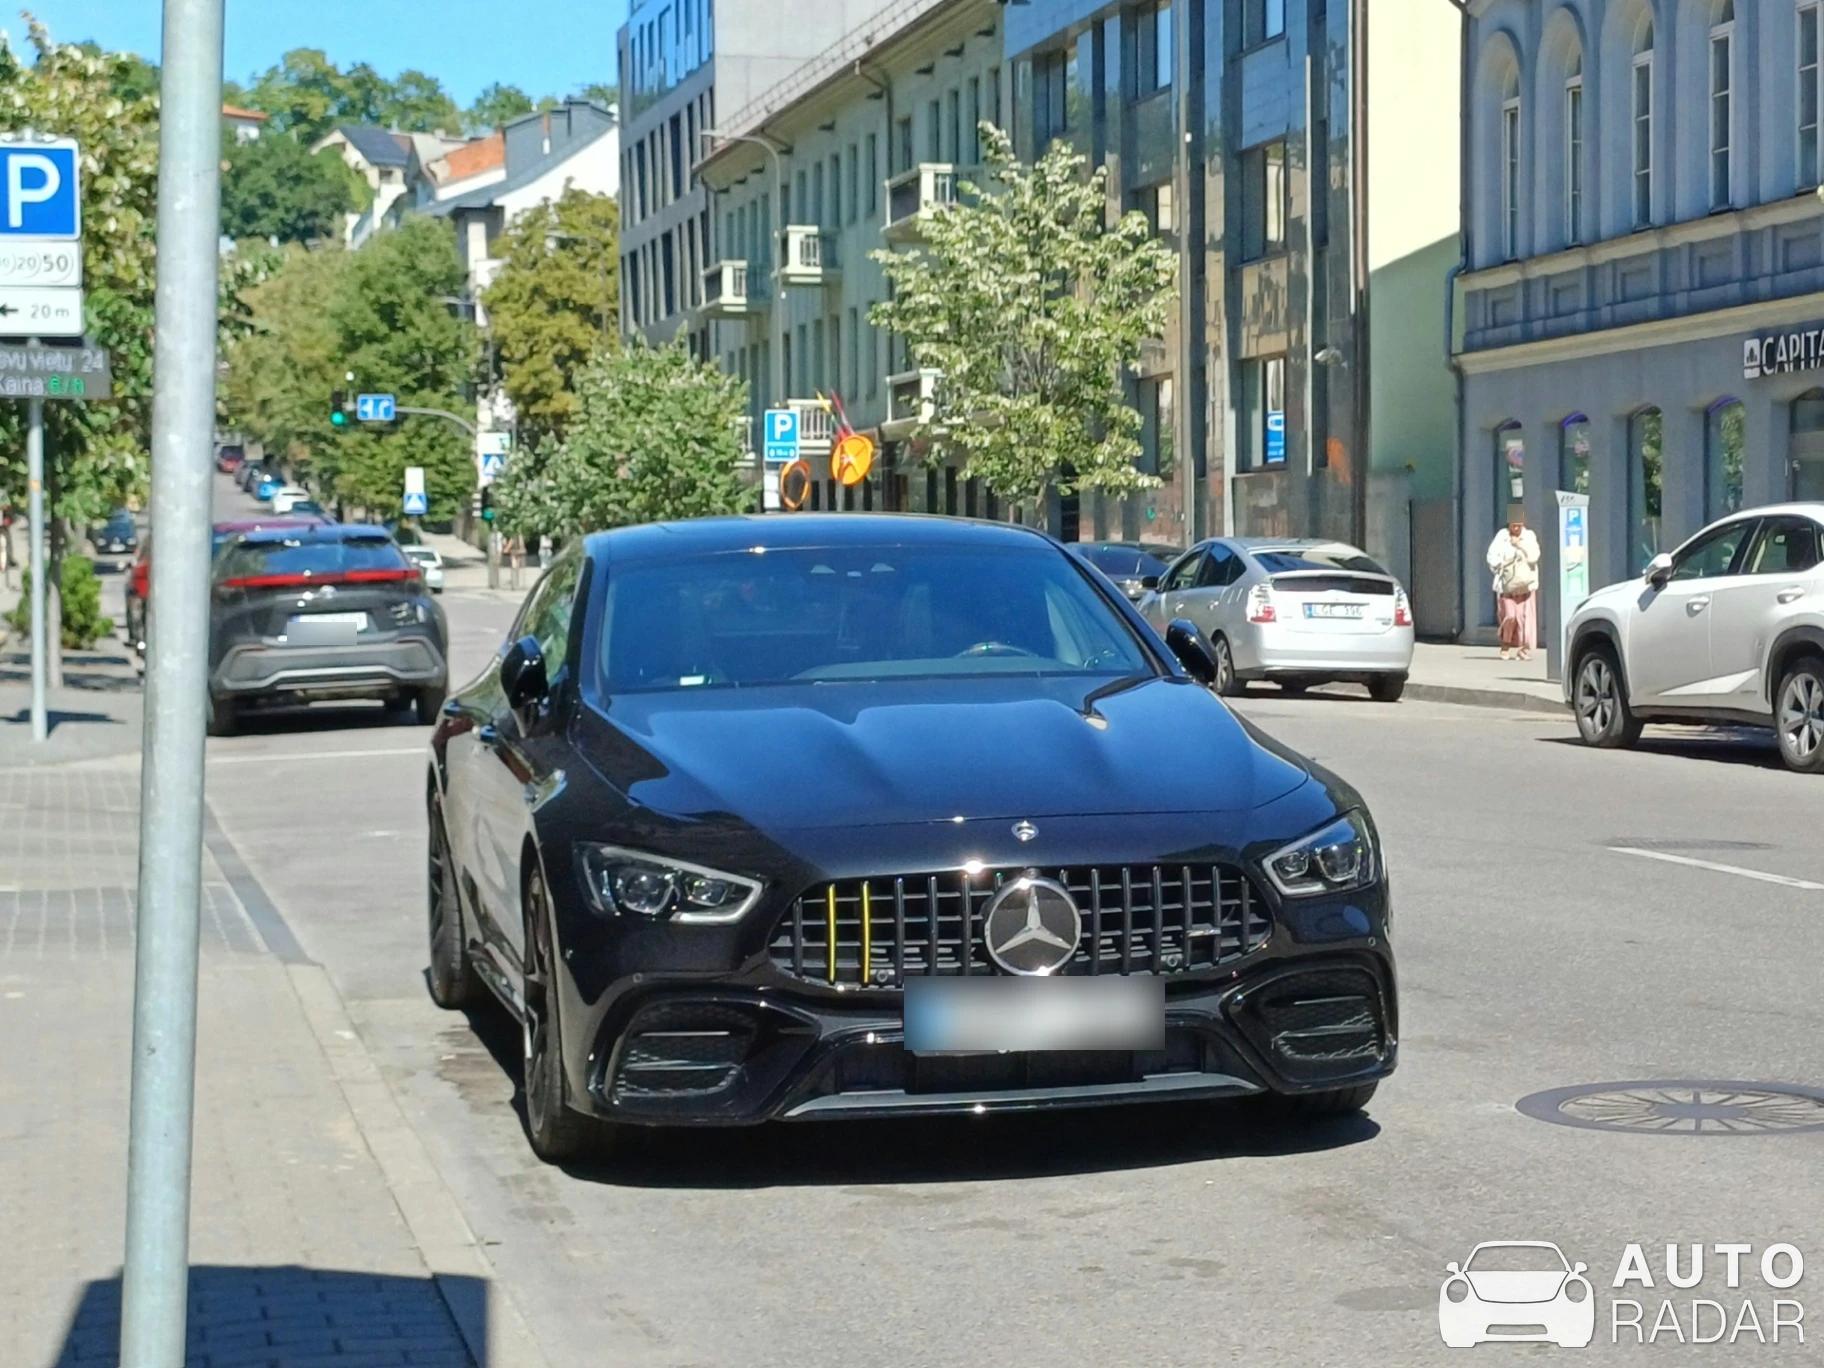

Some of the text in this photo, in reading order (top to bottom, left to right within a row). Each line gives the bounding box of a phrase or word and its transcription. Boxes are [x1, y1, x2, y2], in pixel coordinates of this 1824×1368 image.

[8, 153, 61, 228] P
[43, 253, 69, 272] 50
[30, 303, 70, 319] 20 m
[81, 349, 104, 373] 24
[774, 413, 793, 440] P
